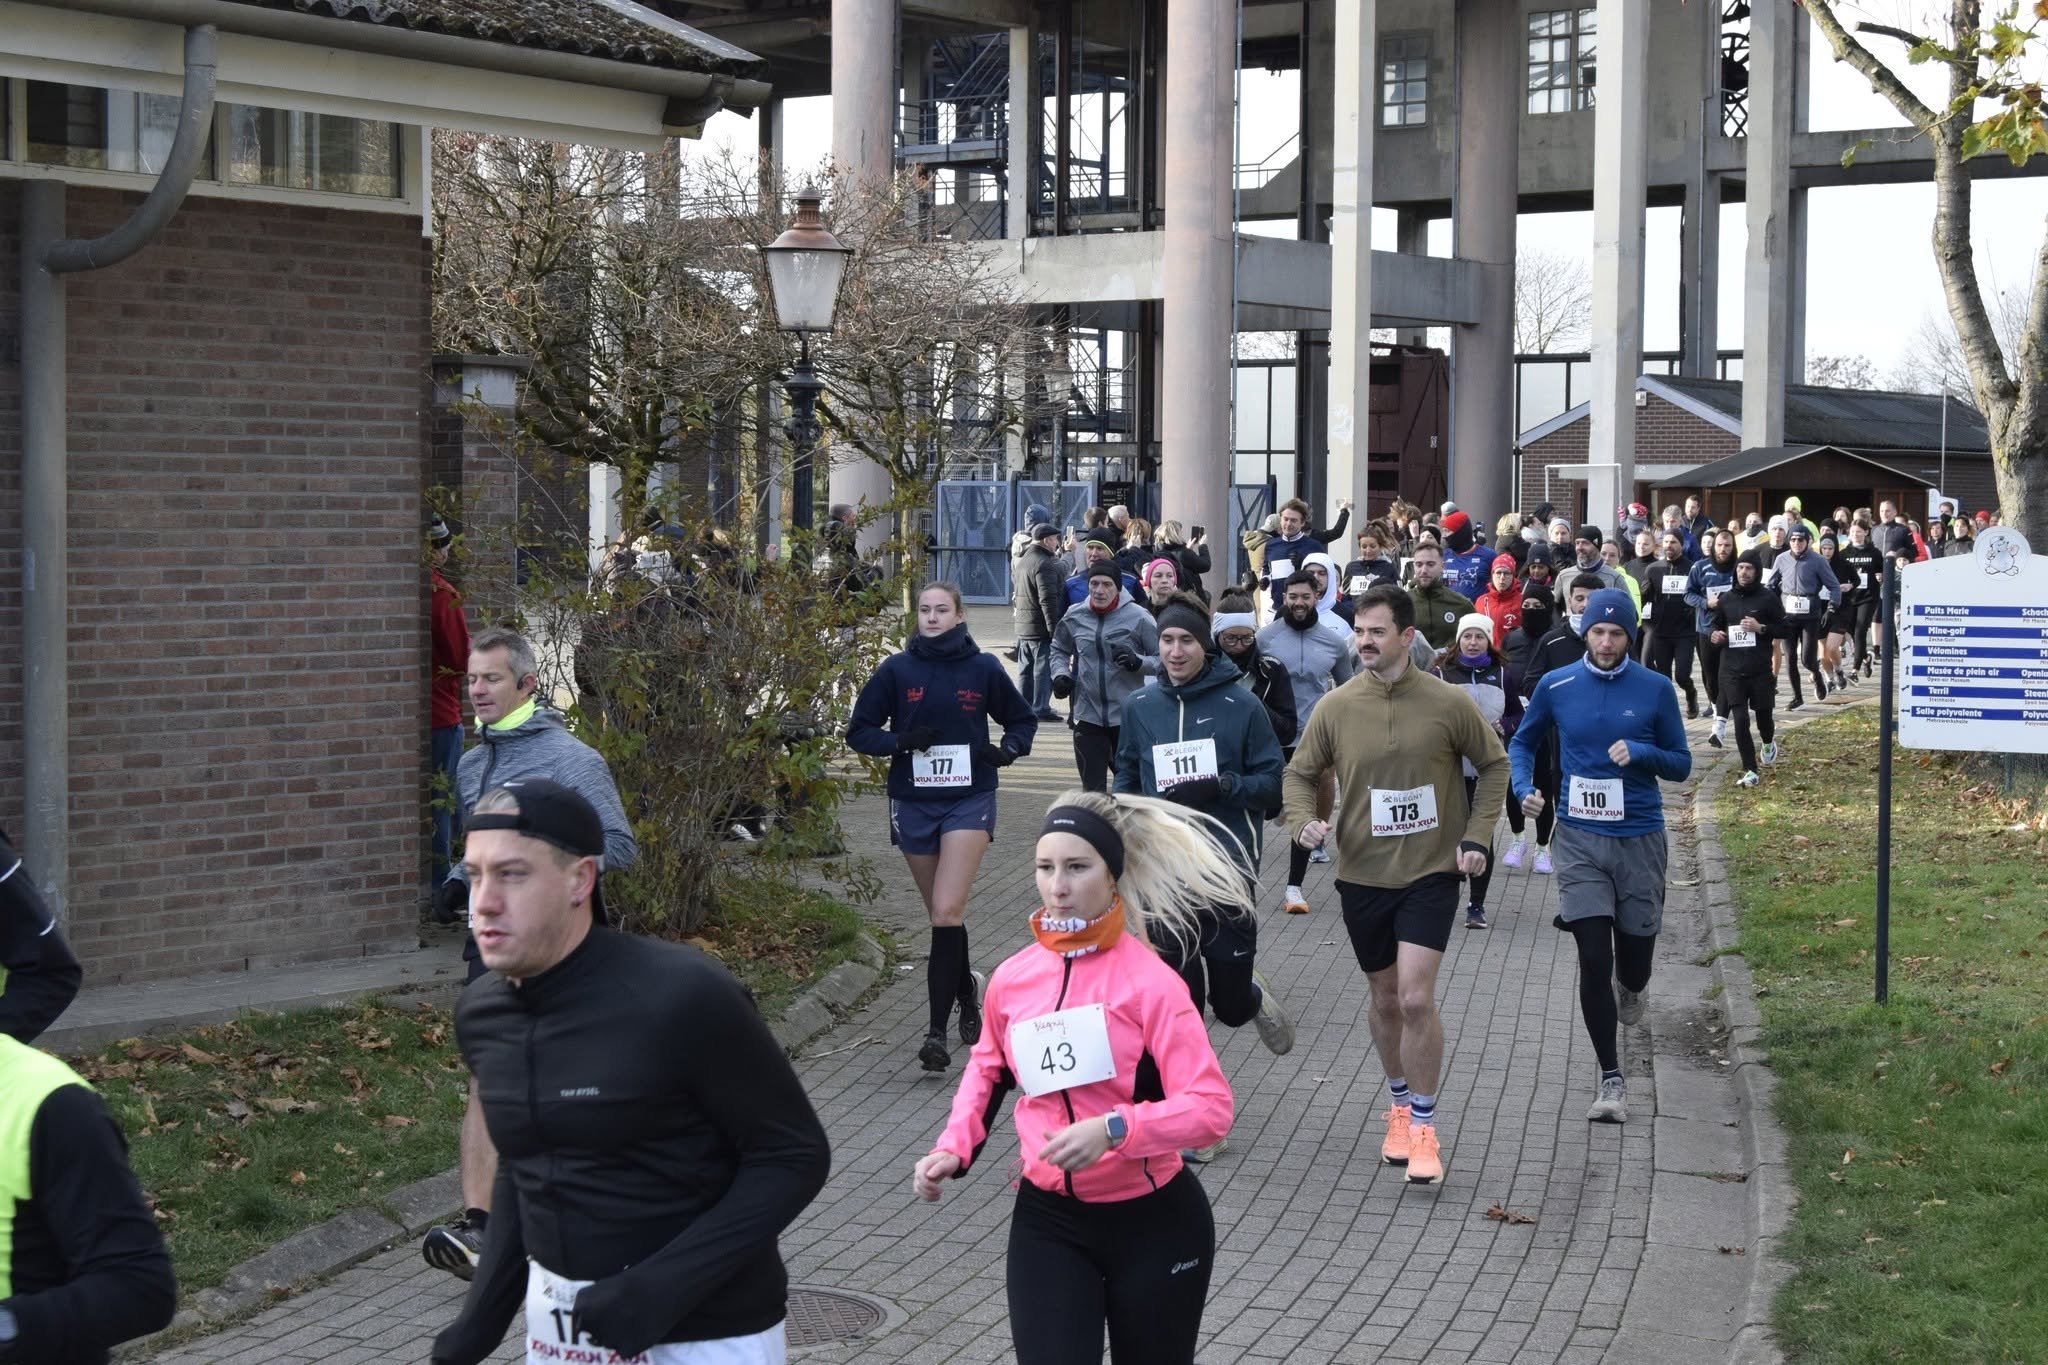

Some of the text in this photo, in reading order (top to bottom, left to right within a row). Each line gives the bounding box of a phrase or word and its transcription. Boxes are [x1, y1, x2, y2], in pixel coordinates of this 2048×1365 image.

[1671, 580, 1680, 588] 57
[1924, 606, 1970, 615] Puits Marie
[1734, 632, 1748, 640] 162
[1928, 626, 1966, 636] Mine-golf
[1928, 646, 1968, 656] Vélomines
[1928, 666, 1952, 675] Musée
[1966, 668, 1986, 676] plein
[1928, 686, 1949, 694] Terril
[1916, 707, 1982, 718] Salle polyvalente
[1174, 746, 1203, 754] BLEGNY
[930, 758, 953, 775] 177
[1172, 754, 1197, 775] 111
[1393, 793, 1423, 802] BLEGNY
[1582, 791, 1606, 808] 110
[1389, 802, 1419, 822] 173
[1395, 822, 1416, 830] XRUN
[1417, 816, 1436, 827] XRUN
[1041, 1042, 1076, 1074] 43
